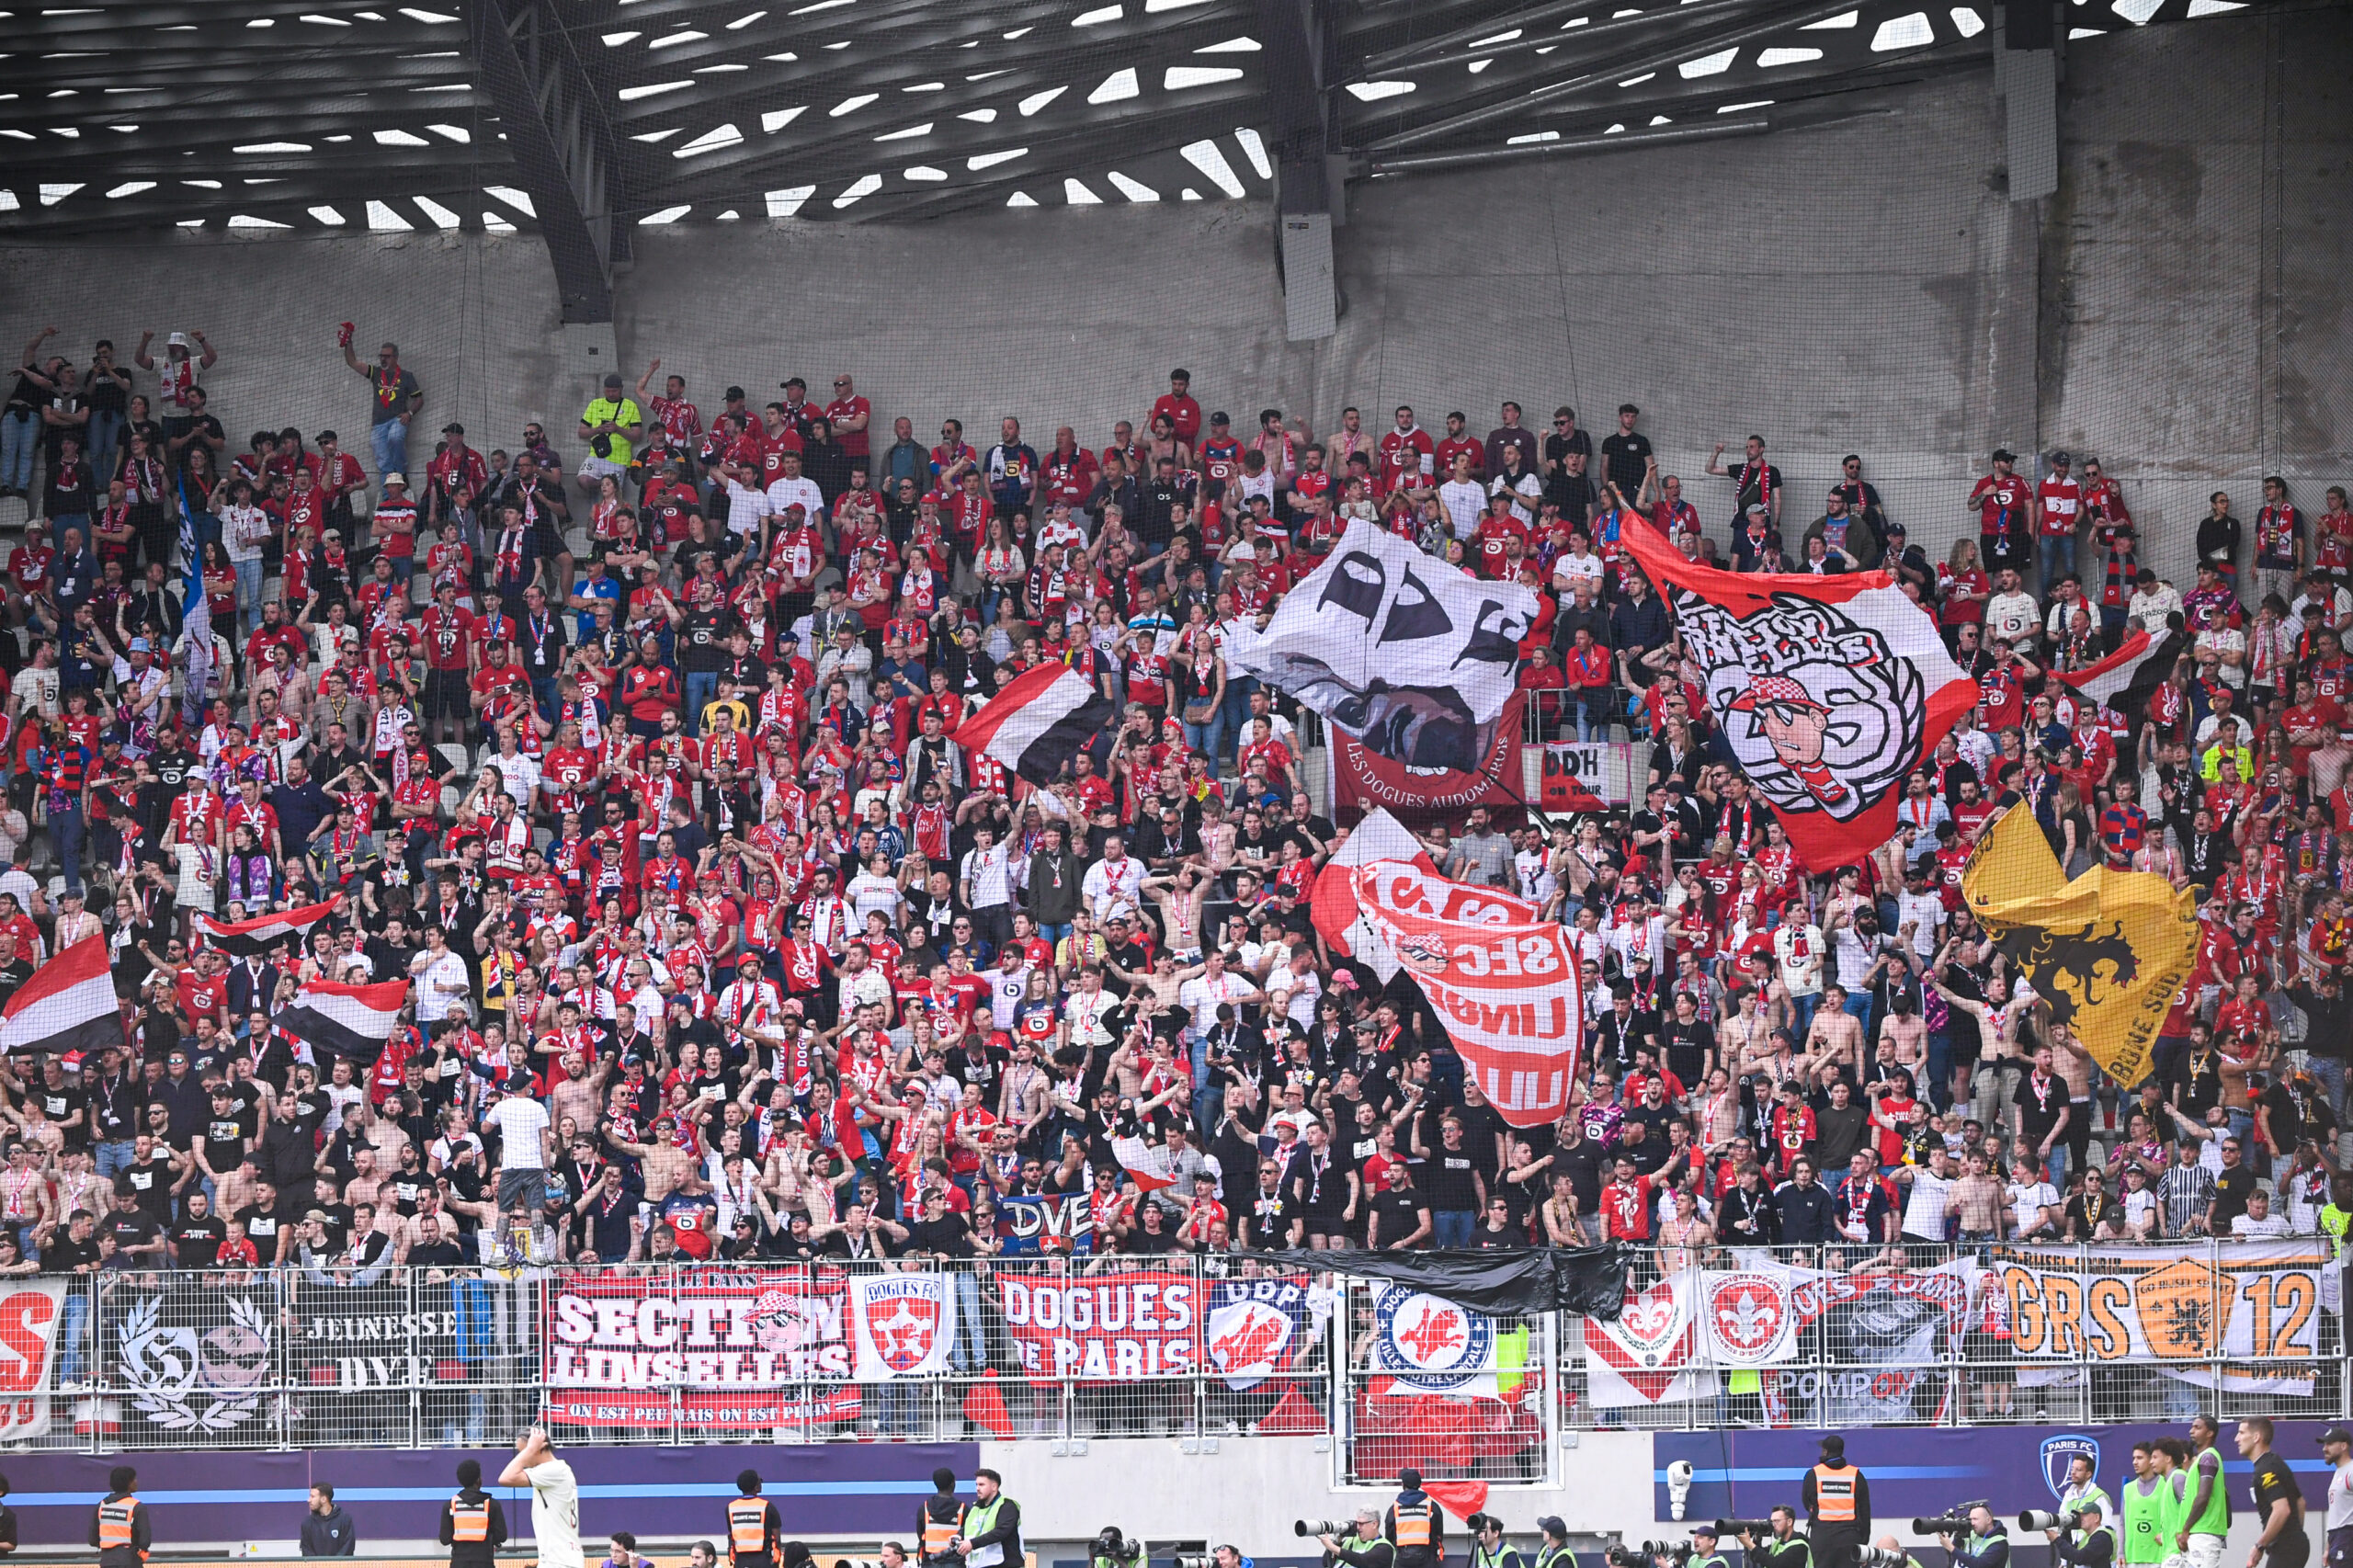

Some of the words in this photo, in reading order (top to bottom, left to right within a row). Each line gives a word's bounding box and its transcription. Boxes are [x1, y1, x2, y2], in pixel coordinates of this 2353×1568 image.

[1362, 769, 1426, 808] DOGUES
[1572, 784, 1603, 796] TOUR
[2142, 967, 2181, 1014] SUD
[1003, 1193, 1094, 1241] DVE
[708, 1272, 758, 1289] FANS
[869, 1280, 918, 1301] DOGUES
[1003, 1281, 1192, 1332] DOGUES
[2003, 1266, 2131, 1360] GRS
[2243, 1271, 2316, 1358] 12
[308, 1312, 458, 1341] JEUNESSE
[1052, 1337, 1192, 1381] PARIS
[569, 1403, 591, 1418] ON
[597, 1406, 629, 1420] EST
[634, 1408, 667, 1421] PEU
[674, 1408, 714, 1422] MAIS
[720, 1409, 742, 1422] ON
[747, 1407, 778, 1421] EST
[2047, 1441, 2077, 1452] PARIS
[2079, 1442, 2093, 1452] FC
